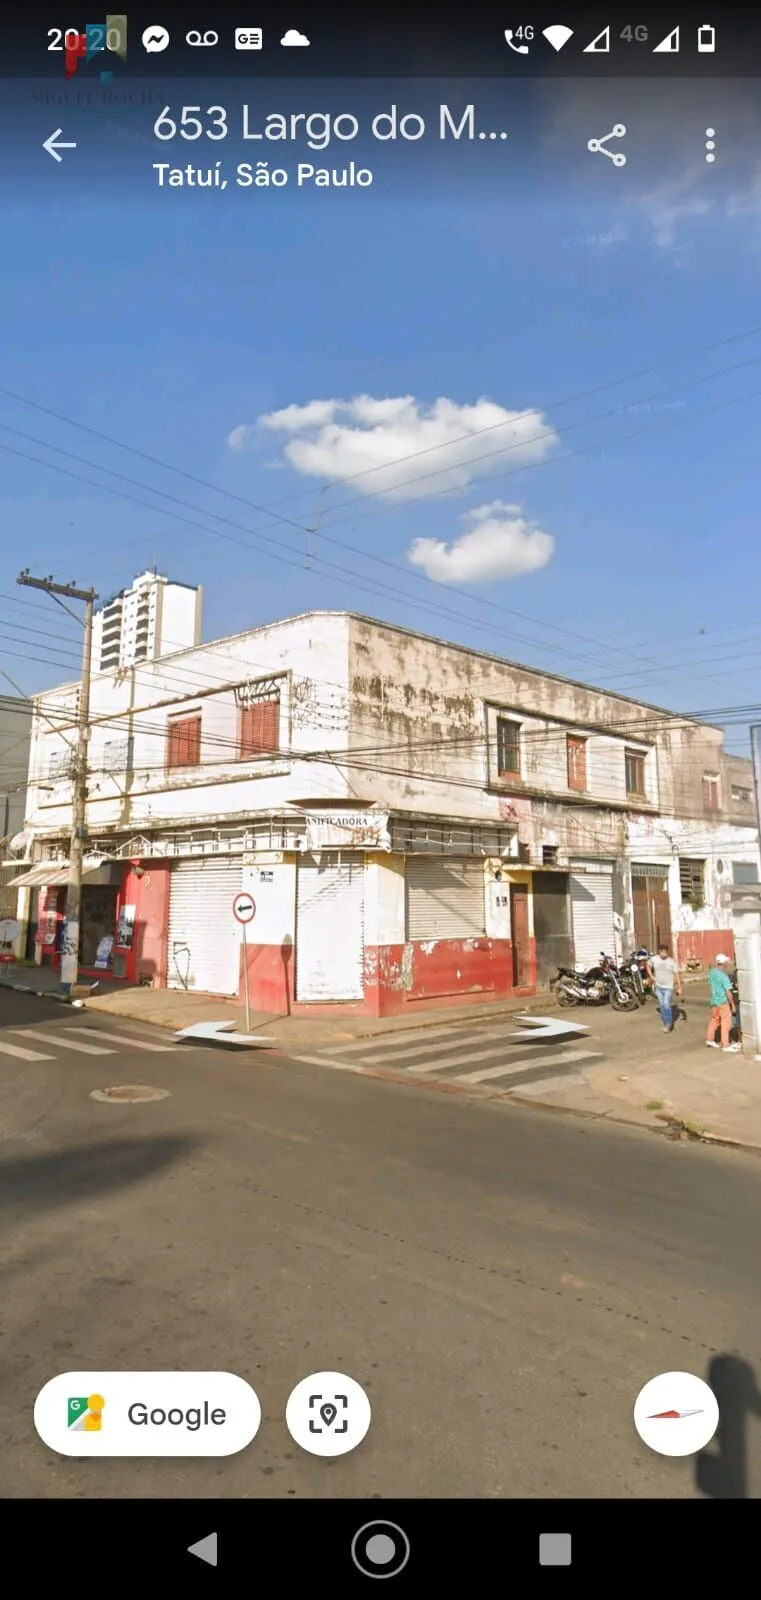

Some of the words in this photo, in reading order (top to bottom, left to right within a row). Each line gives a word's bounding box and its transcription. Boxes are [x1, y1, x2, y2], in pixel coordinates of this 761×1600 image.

[48, 29, 121, 50] 20:20
[515, 25, 534, 40] 4G
[619, 25, 649, 42] 4G
[153, 105, 228, 140] 653
[243, 105, 358, 150] Largo
[371, 105, 425, 140] do
[439, 105, 508, 140] M...
[153, 161, 228, 190] Tatuí,
[236, 161, 288, 187] São
[298, 161, 373, 187] Paulo
[70, 1400, 81, 1411] G
[127, 1400, 226, 1432] Google
